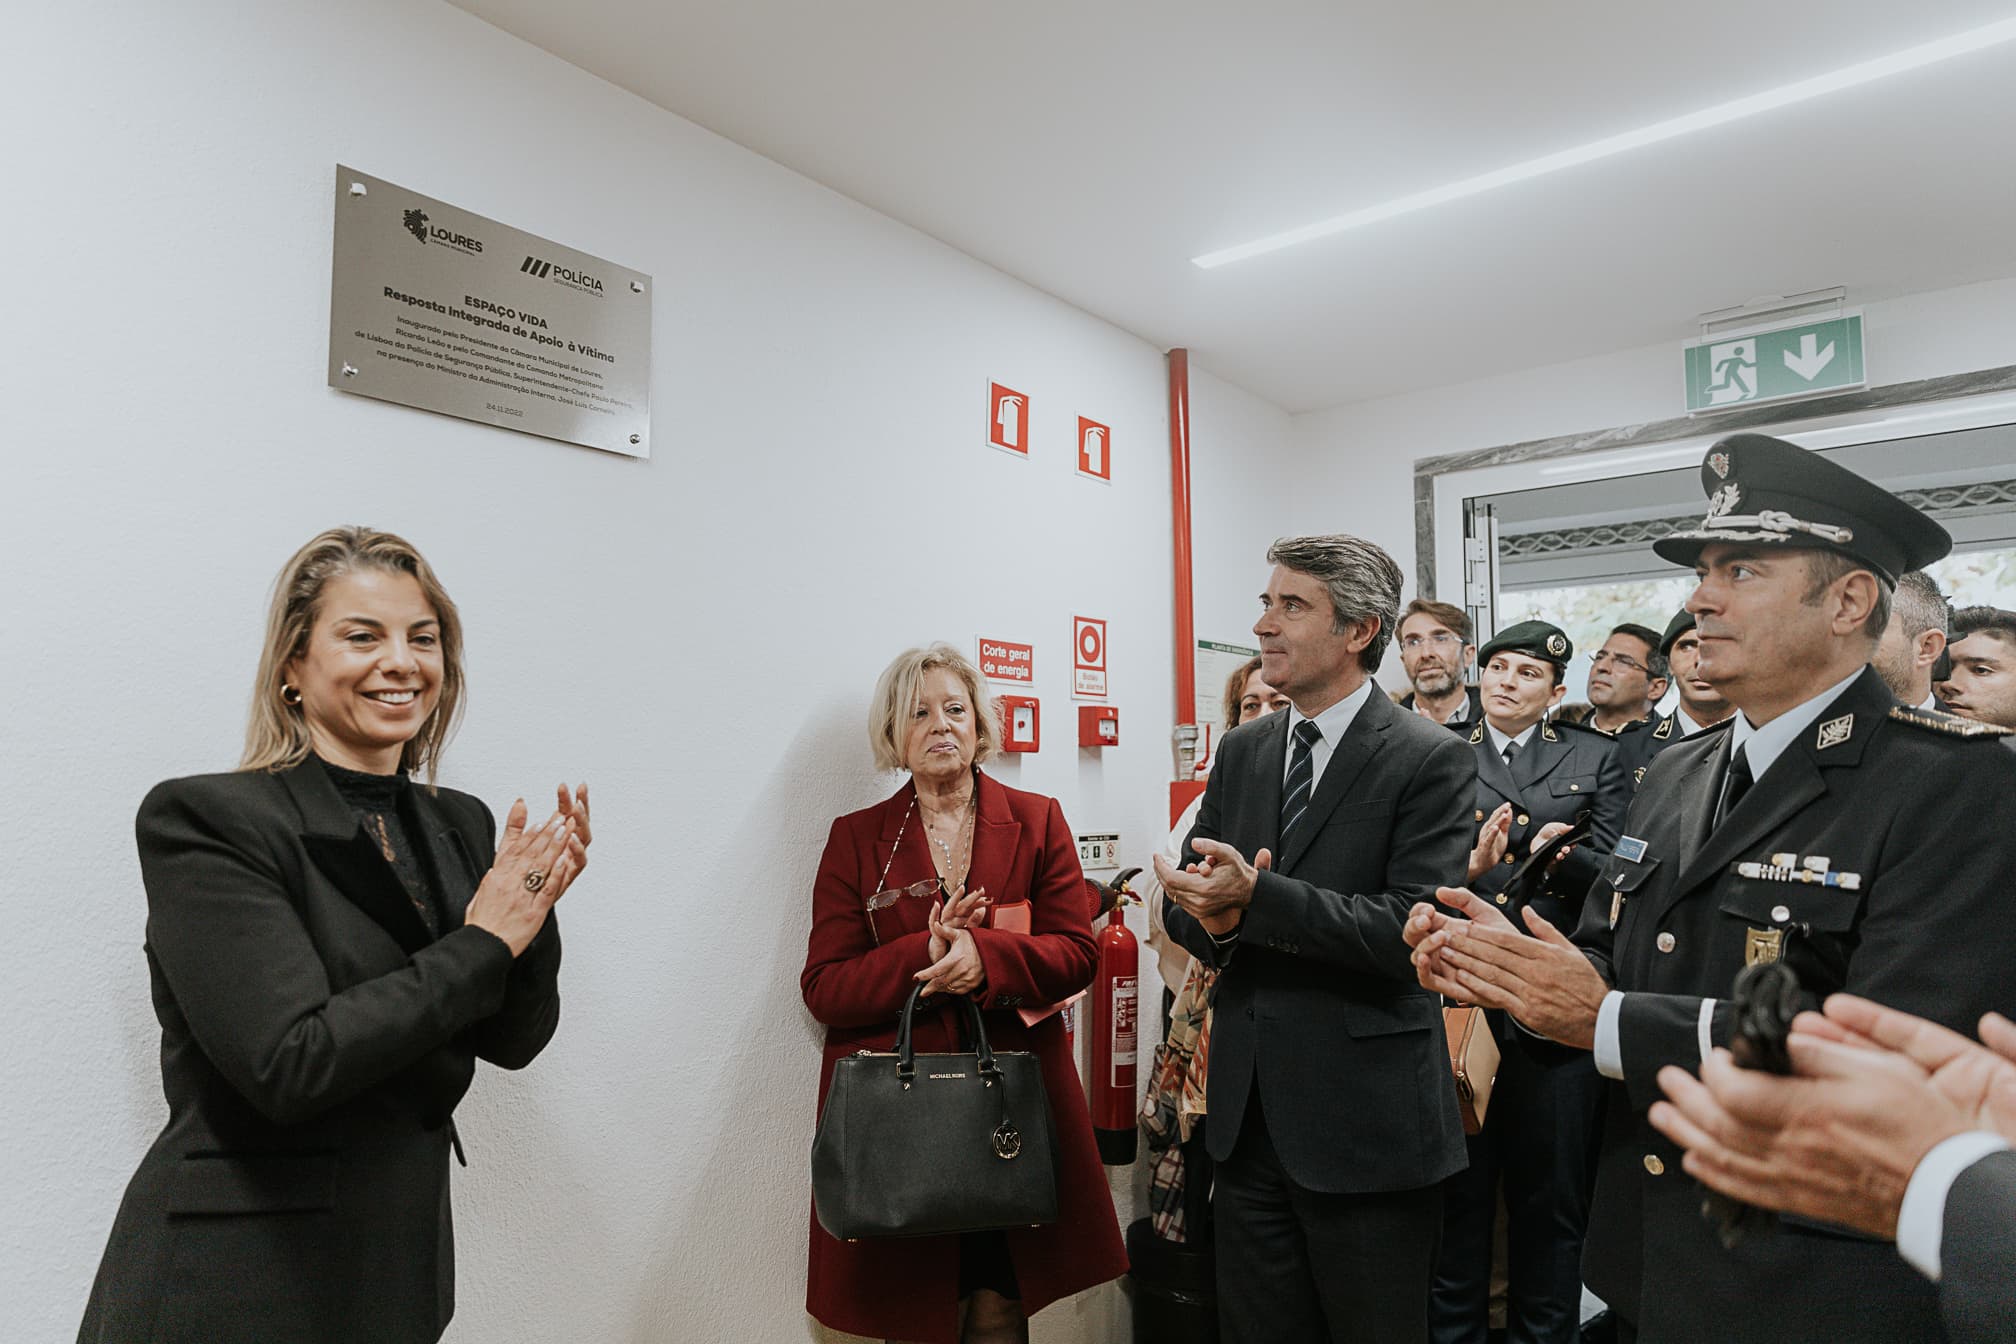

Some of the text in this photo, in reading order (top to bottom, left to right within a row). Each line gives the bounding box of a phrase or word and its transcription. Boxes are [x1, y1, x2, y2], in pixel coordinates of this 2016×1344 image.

[430, 225, 483, 253] LOURES
[553, 265, 604, 292] POLÍCIA
[384, 286, 615, 364] Resposta Integrada de Apoio à Vítima
[464, 295, 548, 330] ESPAÇO VIDA
[354, 330, 366, 339] de
[367, 333, 394, 346] Lisboa
[406, 343, 433, 357] Polícia
[433, 351, 443, 360] de
[444, 353, 484, 371] Segurança
[395, 327, 426, 342] Ricardo
[427, 336, 446, 348] Leão
[446, 342, 452, 350] e
[453, 344, 469, 355] pelo
[470, 349, 515, 367] Comandante
[526, 364, 558, 379] Comando
[559, 372, 604, 391] Metropolitano
[397, 315, 442, 334] Inaugurado
[443, 330, 459, 339] pelo
[460, 333, 499, 350] Presidente
[510, 347, 538, 361] Câmara
[539, 355, 570, 371] Municipal
[571, 365, 580, 373] de
[376, 349, 388, 358] na
[388, 353, 425, 368] presença
[436, 364, 467, 379] Ministro
[479, 375, 530, 394] Administração
[983, 643, 1030, 662] Corte geral
[983, 661, 1029, 680] de energia
